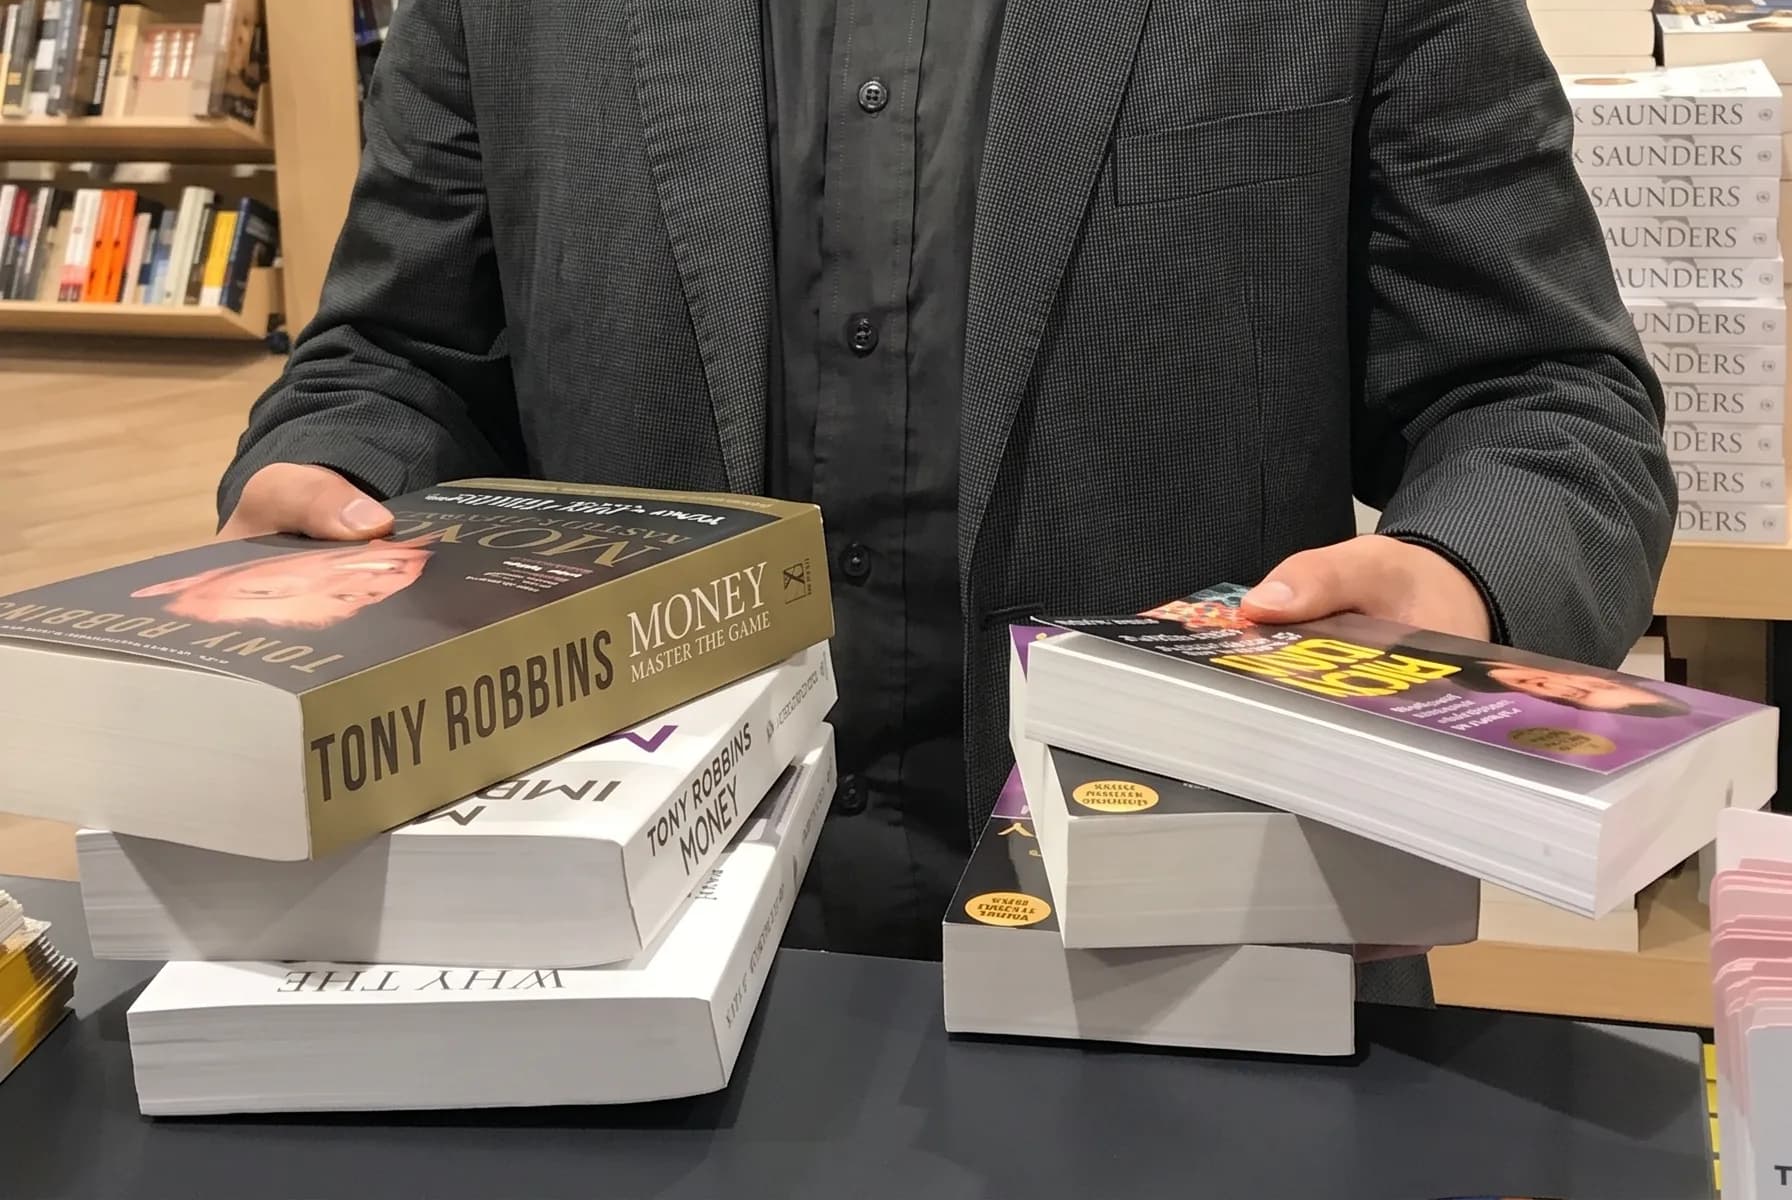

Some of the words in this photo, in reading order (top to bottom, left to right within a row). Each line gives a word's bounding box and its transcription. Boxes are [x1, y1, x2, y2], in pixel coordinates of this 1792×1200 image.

[1592, 103, 1743, 126] SAUNDERS
[1592, 144, 1743, 167] SAUNDERS
[1605, 226, 1737, 248] AUNDERS
[1614, 267, 1744, 289] AUNDERS
[1630, 312, 1747, 335] UNDERS
[1652, 352, 1746, 375] NDERS
[1667, 392, 1745, 414] DERS
[1668, 431, 1743, 454] DERS
[1675, 471, 1745, 493] DERS
[1677, 511, 1747, 532] DERS
[626, 561, 768, 659] MONEY
[192, 631, 345, 674] TONY
[630, 646, 693, 684] MASTER
[695, 632, 726, 661] THE
[728, 611, 772, 642] GAME
[310, 699, 427, 802] TONY
[445, 629, 615, 752] ROBBINS
[646, 806, 689, 858] TONY
[691, 721, 754, 807] ROBBINS
[679, 774, 740, 877] MONEY
[277, 969, 399, 993] THE
[419, 967, 567, 991] WHY
